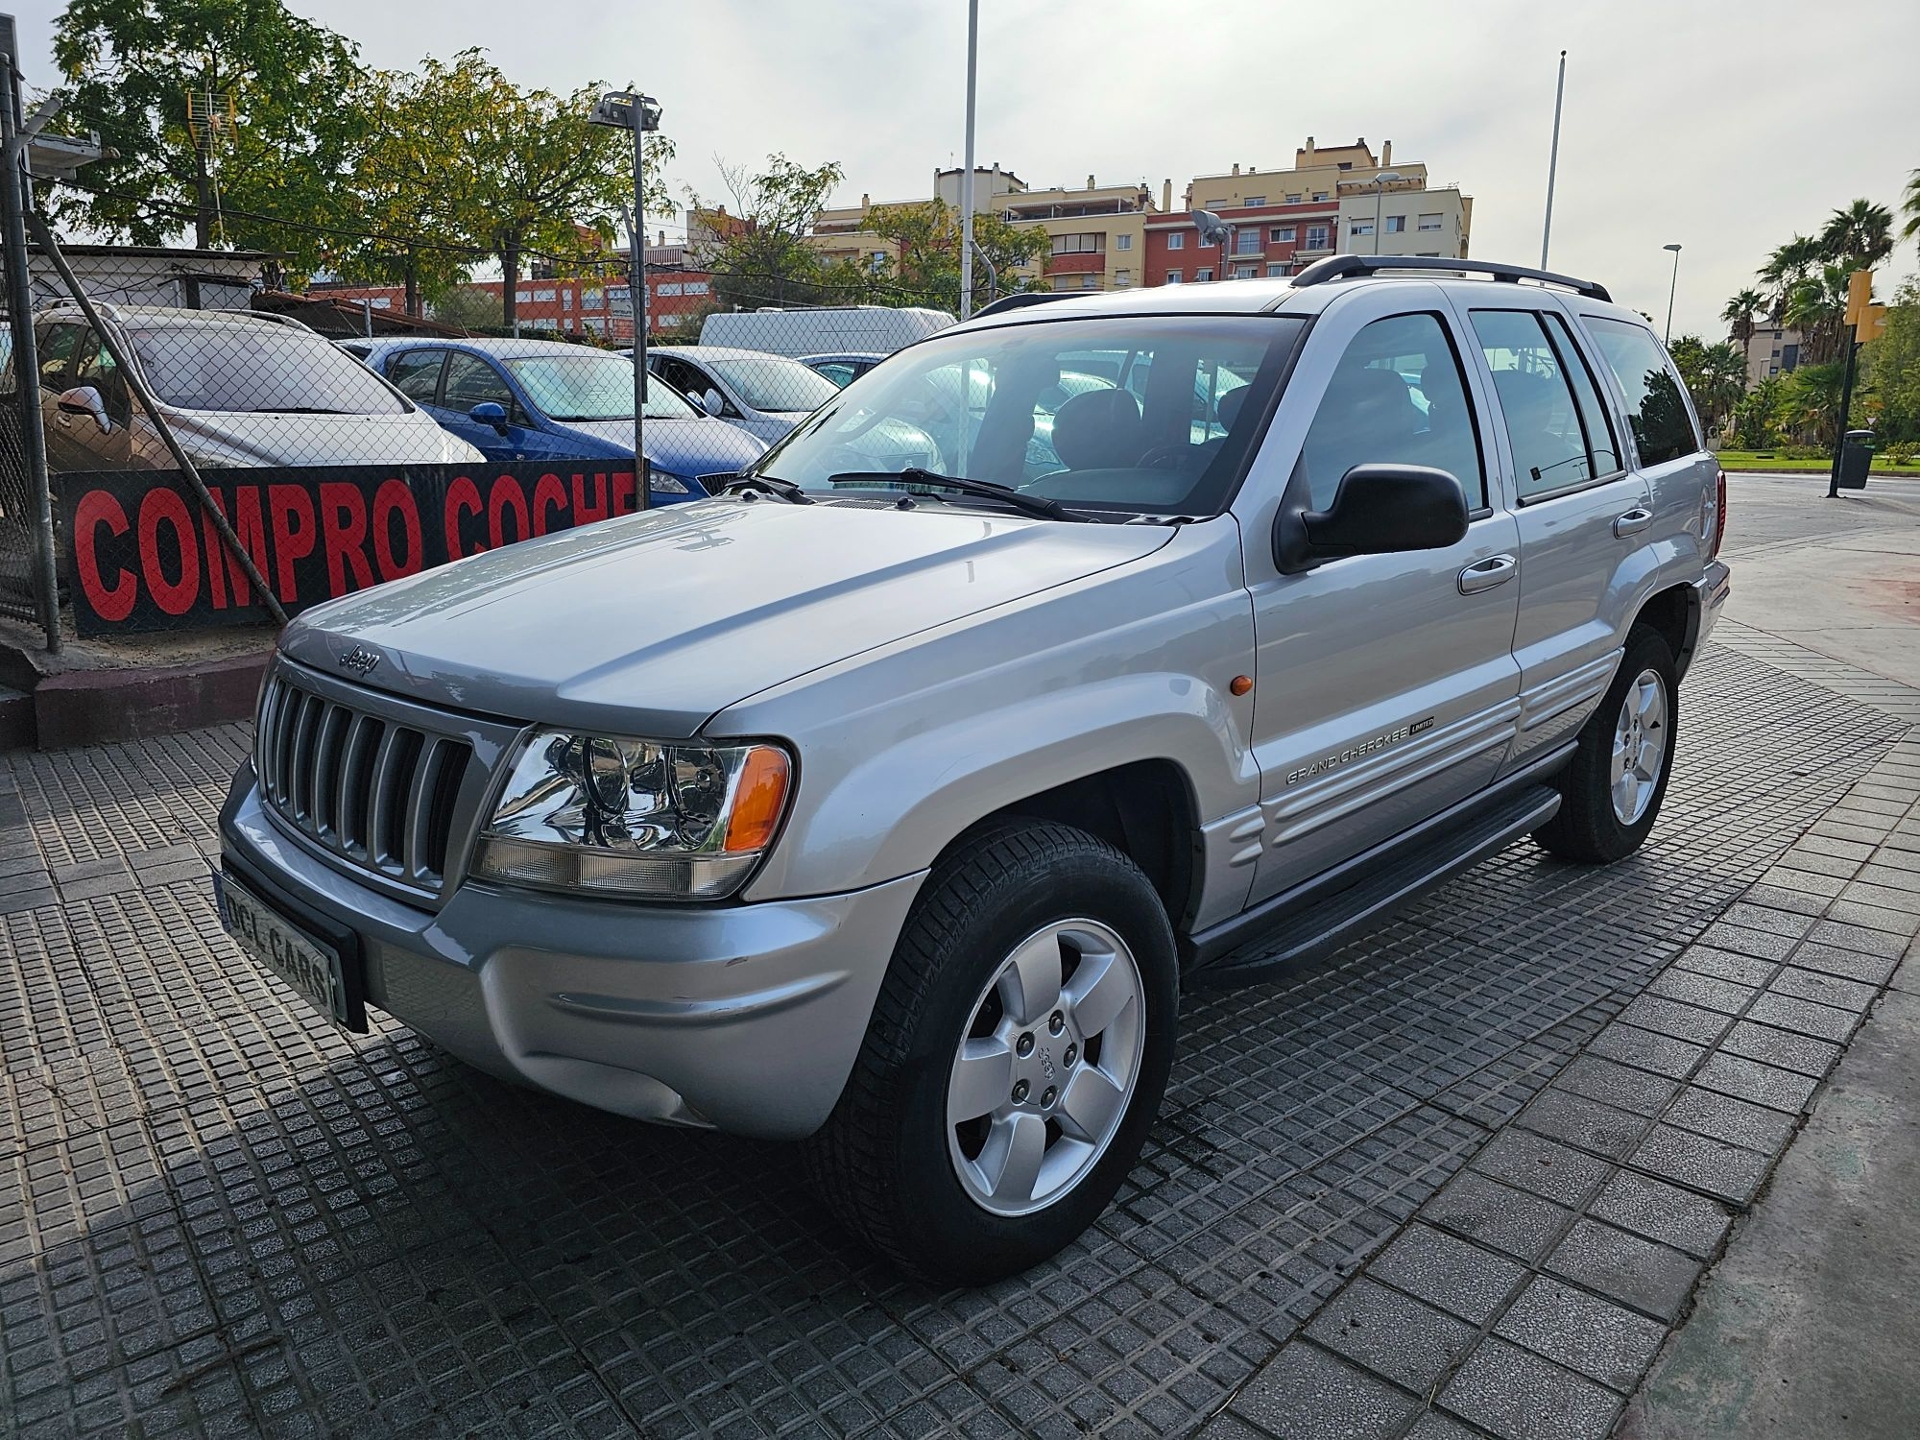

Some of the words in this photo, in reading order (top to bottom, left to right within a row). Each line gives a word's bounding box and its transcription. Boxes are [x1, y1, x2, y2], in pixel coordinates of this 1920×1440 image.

[74, 479, 423, 622] COMPRO
[339, 644, 380, 678] Jeep
[1286, 755, 1337, 785] GRAND
[1340, 726, 1409, 764] CHEROKEE
[269, 927, 328, 1007] CARS
